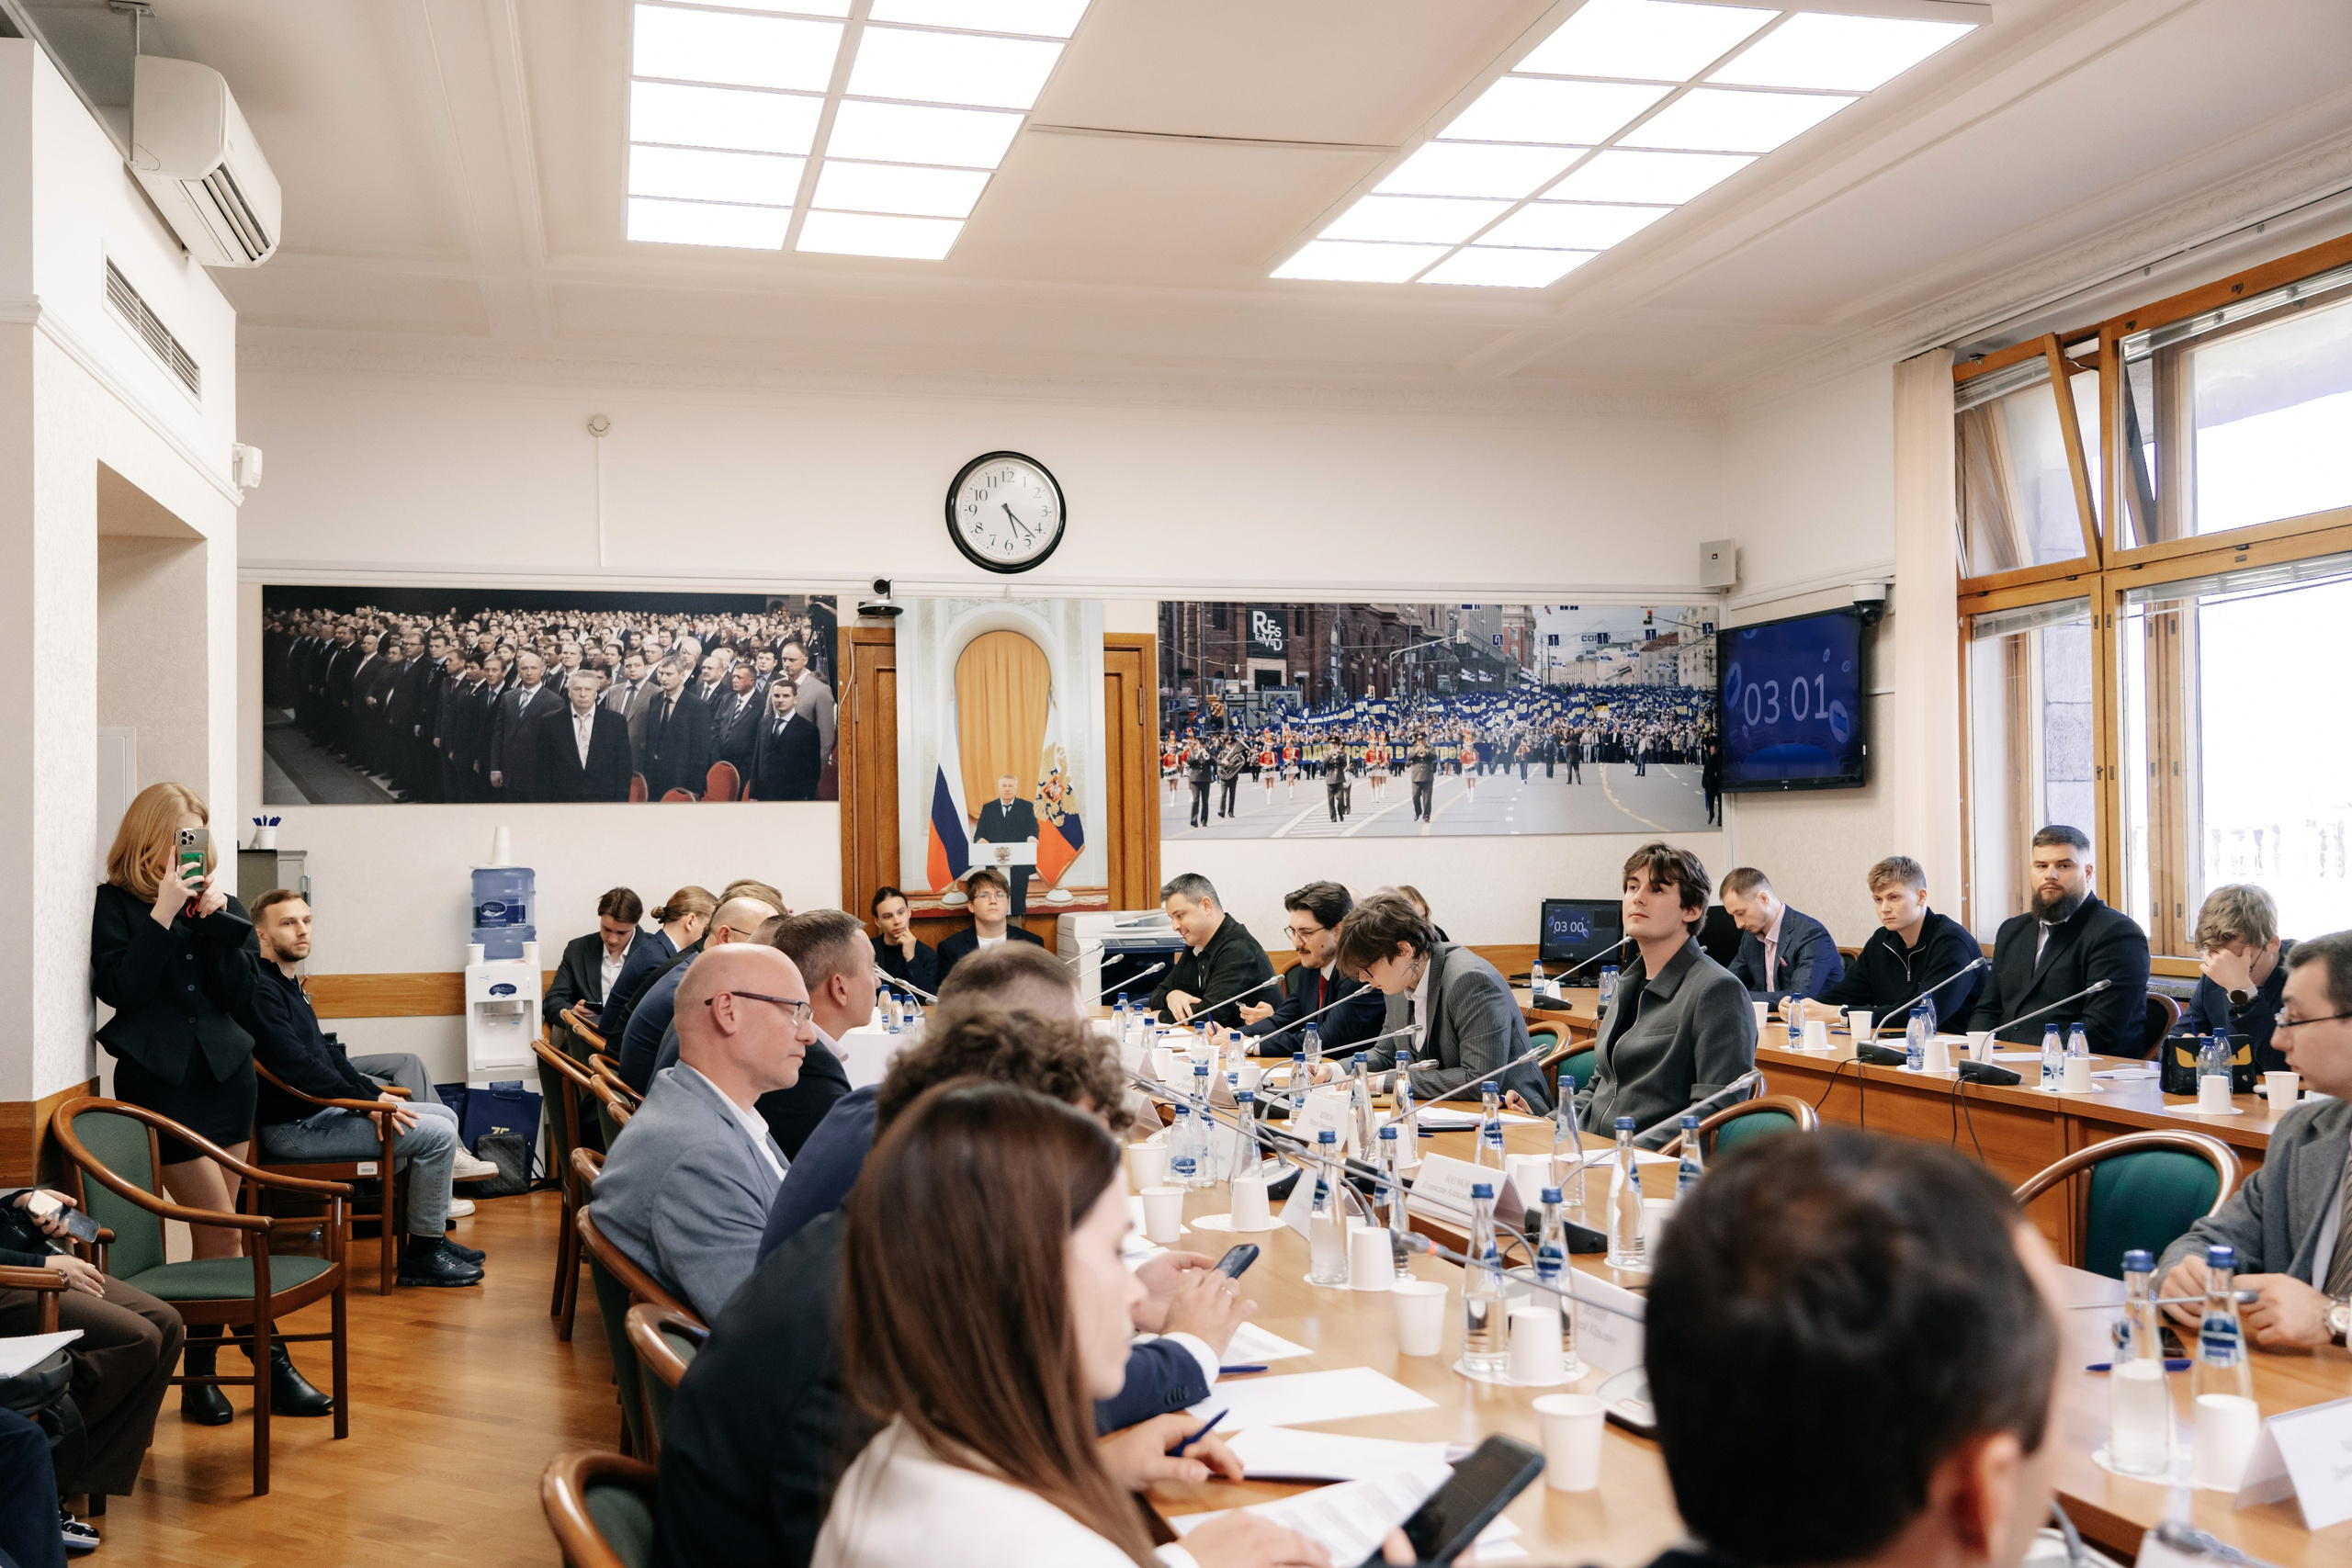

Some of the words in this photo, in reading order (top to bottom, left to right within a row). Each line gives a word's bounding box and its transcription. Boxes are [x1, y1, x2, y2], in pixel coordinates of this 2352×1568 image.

[987, 476, 998, 488] 11
[1001, 470, 1015, 483] 12
[1023, 476, 1027, 489] 1
[974, 489, 989, 502] 10
[1033, 487, 1041, 499] 2
[968, 504, 978, 517] 9
[1040, 505, 1048, 517] 3
[974, 522, 984, 535] 8
[1035, 522, 1043, 534] 4
[989, 535, 997, 546] 7
[1004, 538, 1014, 552] 6
[1023, 535, 1032, 547] 5
[1444, 1174, 1471, 1190] НАУМОВ
